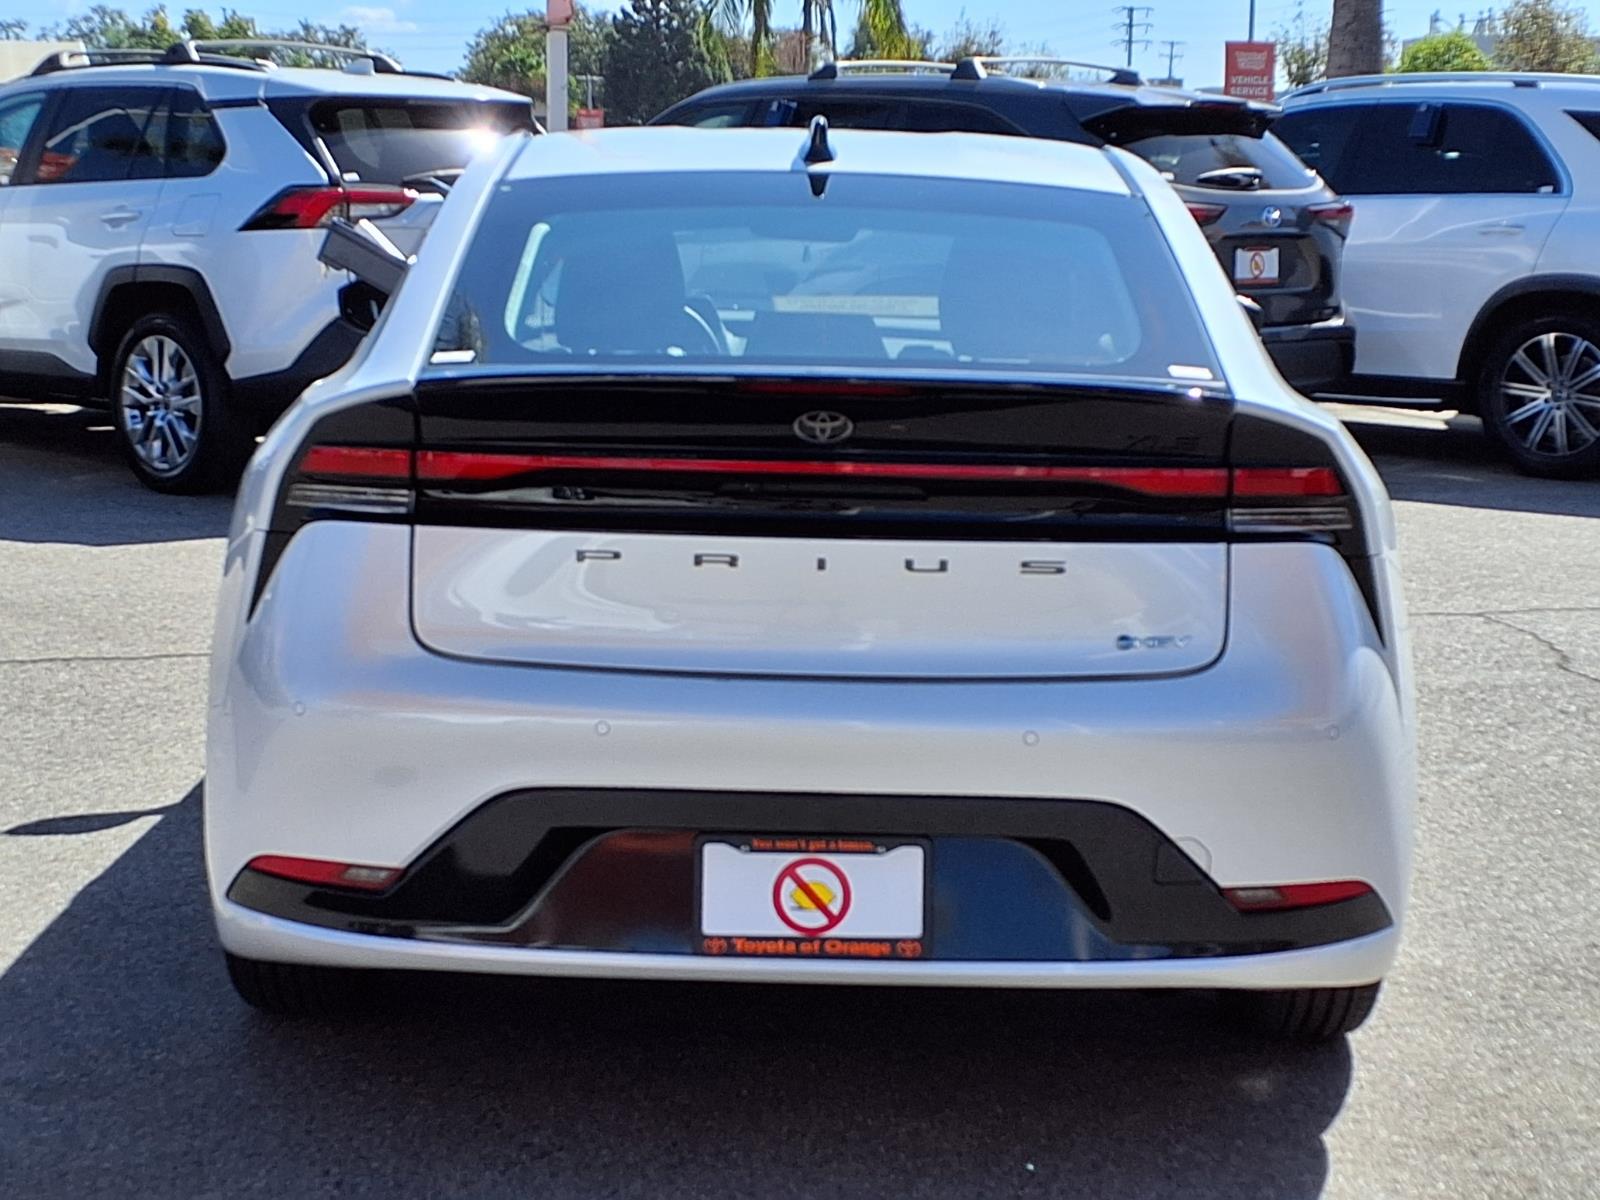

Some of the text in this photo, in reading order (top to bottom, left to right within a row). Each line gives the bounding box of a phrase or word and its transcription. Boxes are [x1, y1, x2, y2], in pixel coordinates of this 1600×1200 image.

[1231, 75, 1269, 84] VEHICLE
[1230, 86, 1268, 96] SERVICE
[576, 549, 1066, 575] PRIUS
[733, 937, 891, 956] Toyota of Orange
